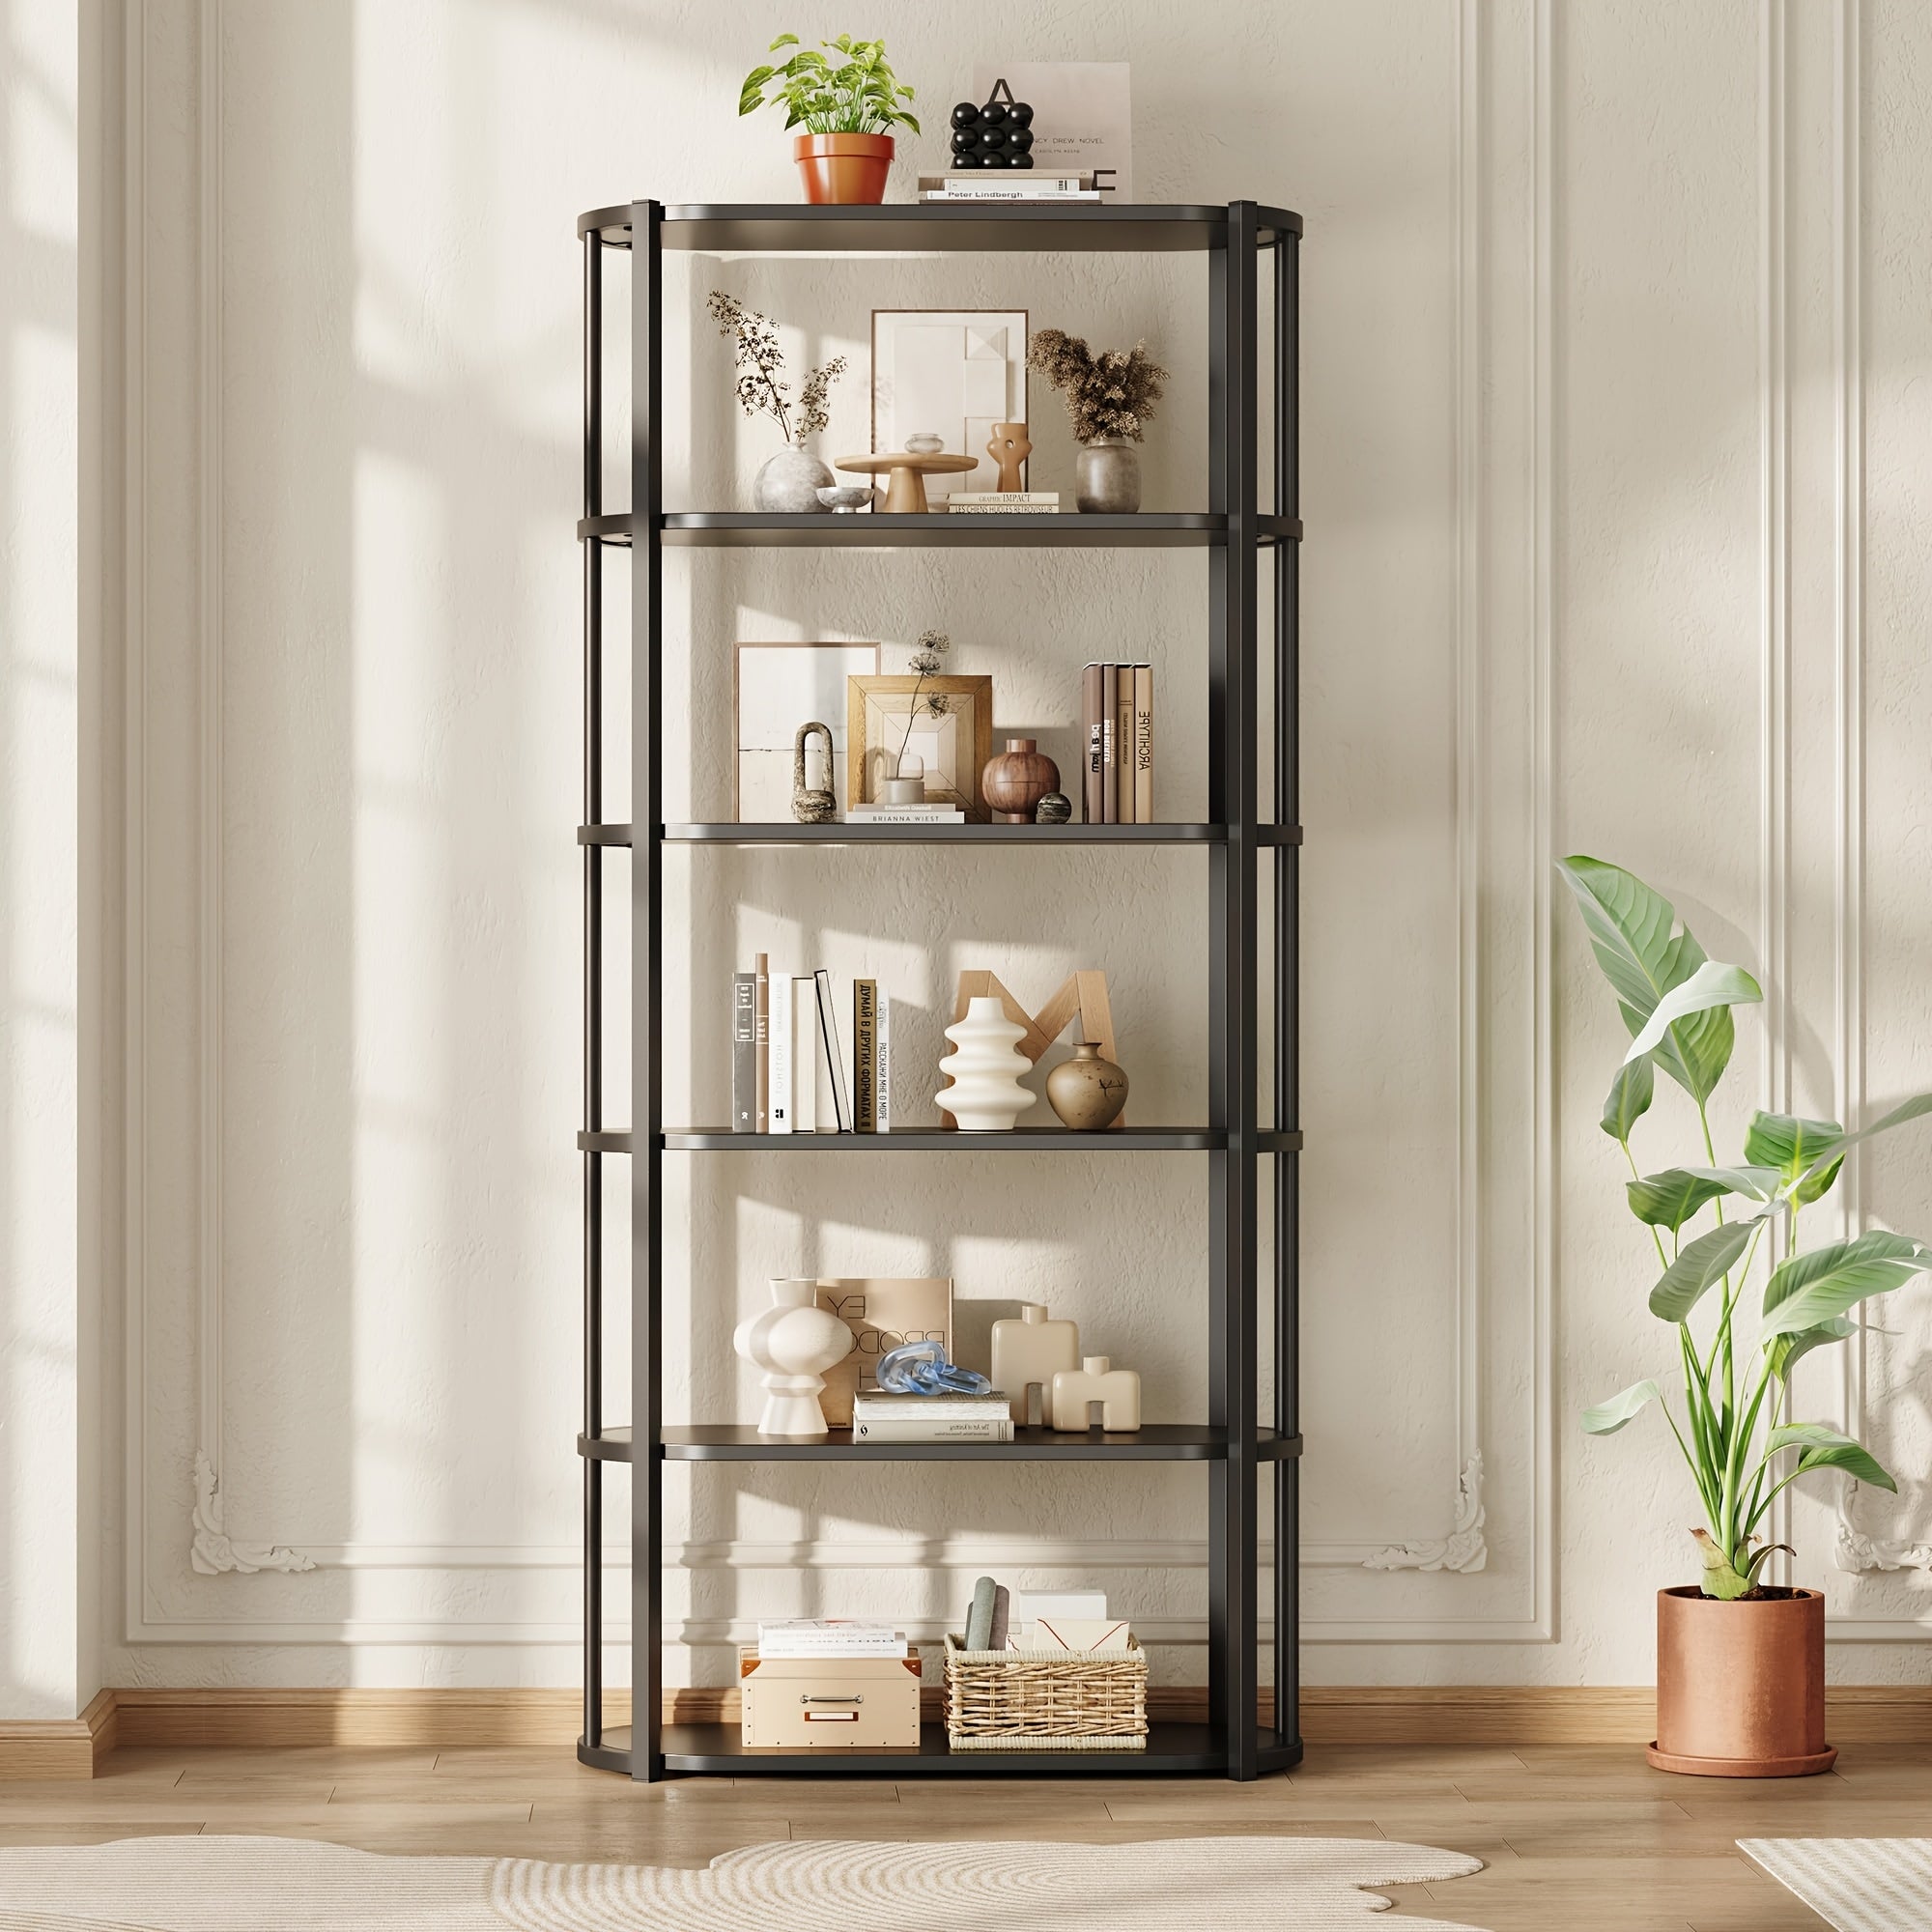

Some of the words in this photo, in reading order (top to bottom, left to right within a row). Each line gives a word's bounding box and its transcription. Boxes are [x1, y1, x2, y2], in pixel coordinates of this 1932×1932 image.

[1003, 494, 1032, 502] IMPACT
[860, 984, 873, 1018] ДУМАЙ
[860, 1030, 871, 1065] ДРУГИХ
[878, 1042, 888, 1077] РАССКАЖИ
[860, 1068, 871, 1119] ФОРМАТАХ
[878, 1079, 888, 1094] МНЕ
[878, 1102, 888, 1120] МОРЕ
